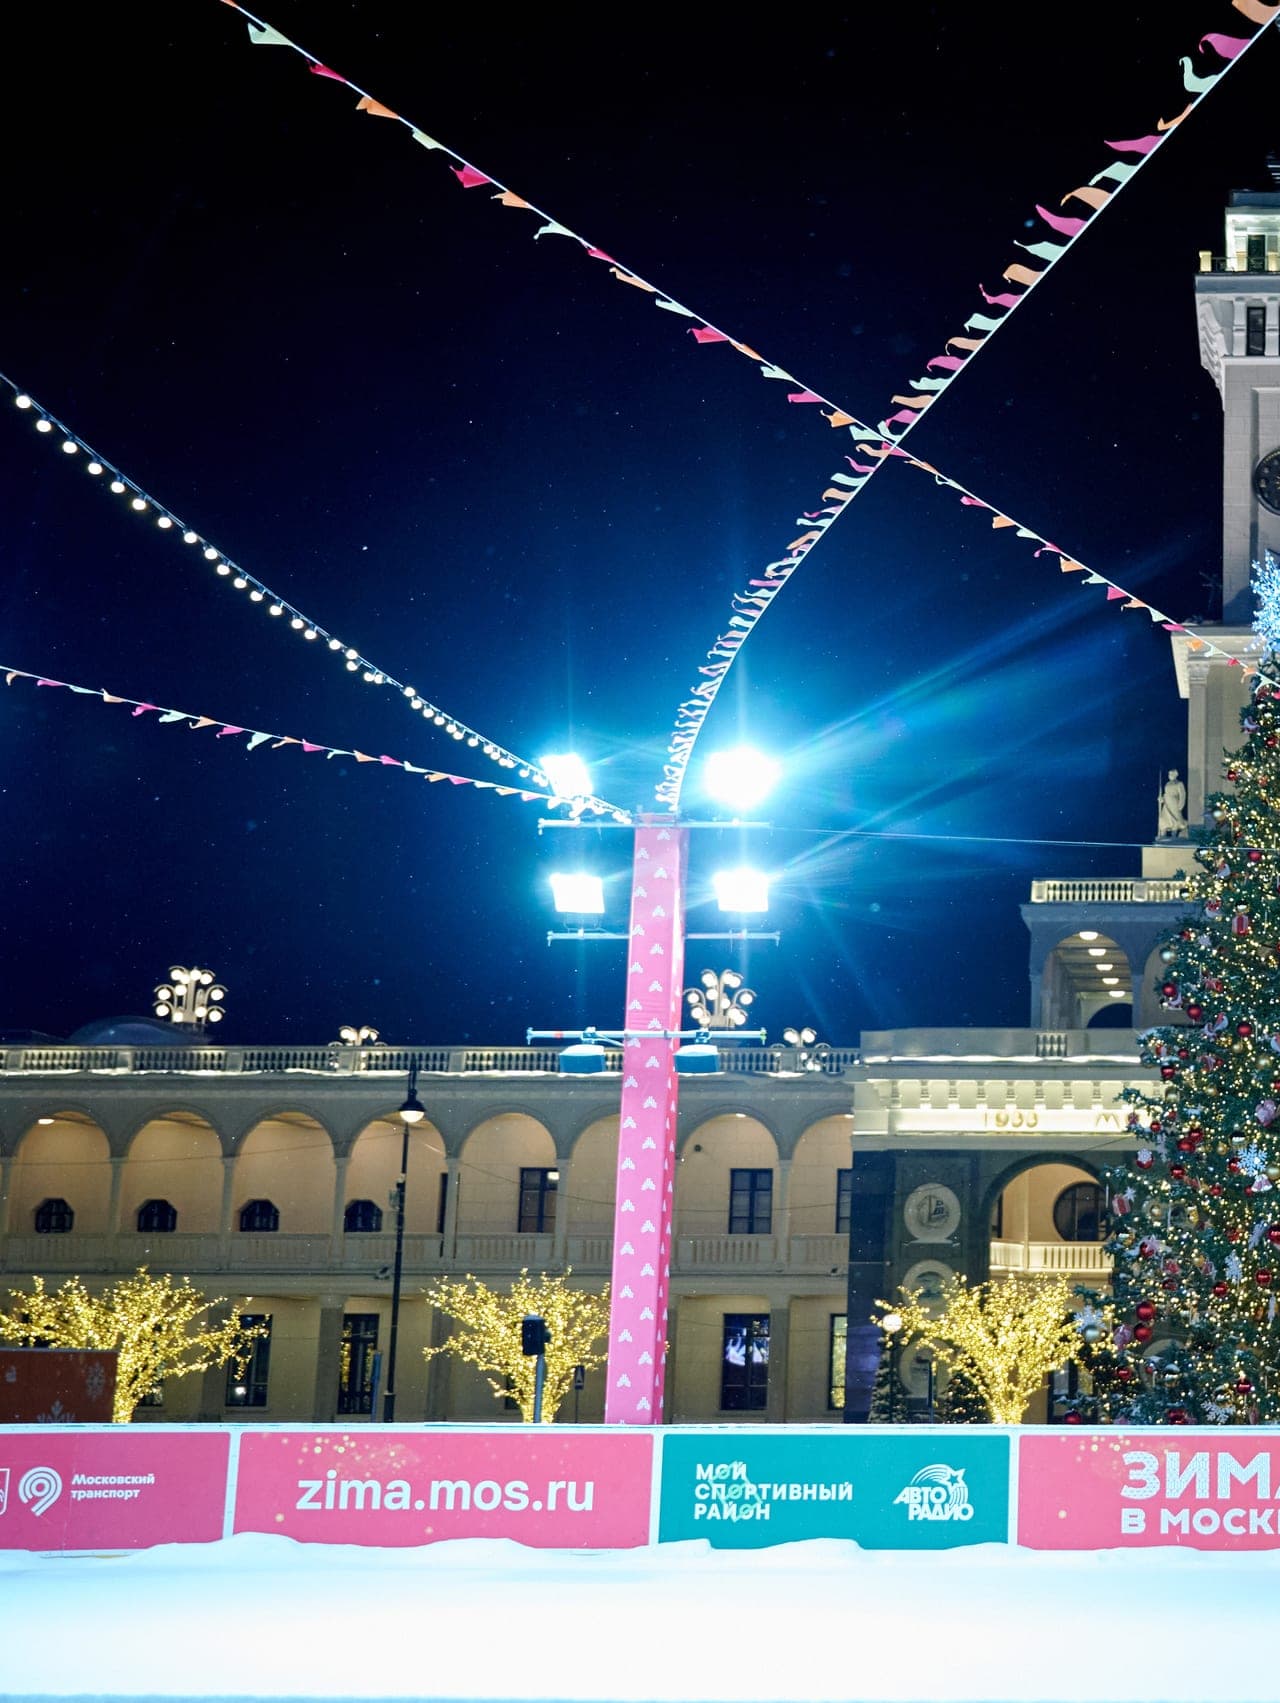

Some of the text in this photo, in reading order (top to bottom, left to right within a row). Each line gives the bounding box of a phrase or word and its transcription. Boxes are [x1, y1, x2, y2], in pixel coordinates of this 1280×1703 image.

[72, 1473, 155, 1485] Московский
[696, 1462, 747, 1480] МОЙ
[71, 1489, 140, 1500] транспорт
[296, 1469, 595, 1511] zima.mos.ru
[695, 1482, 853, 1501] СПОРТИВНЫЙ
[893, 1486, 947, 1504] АВТО
[694, 1502, 770, 1521] РАЙОН
[908, 1503, 974, 1521] РАДИО
[1121, 1508, 1146, 1534] В
